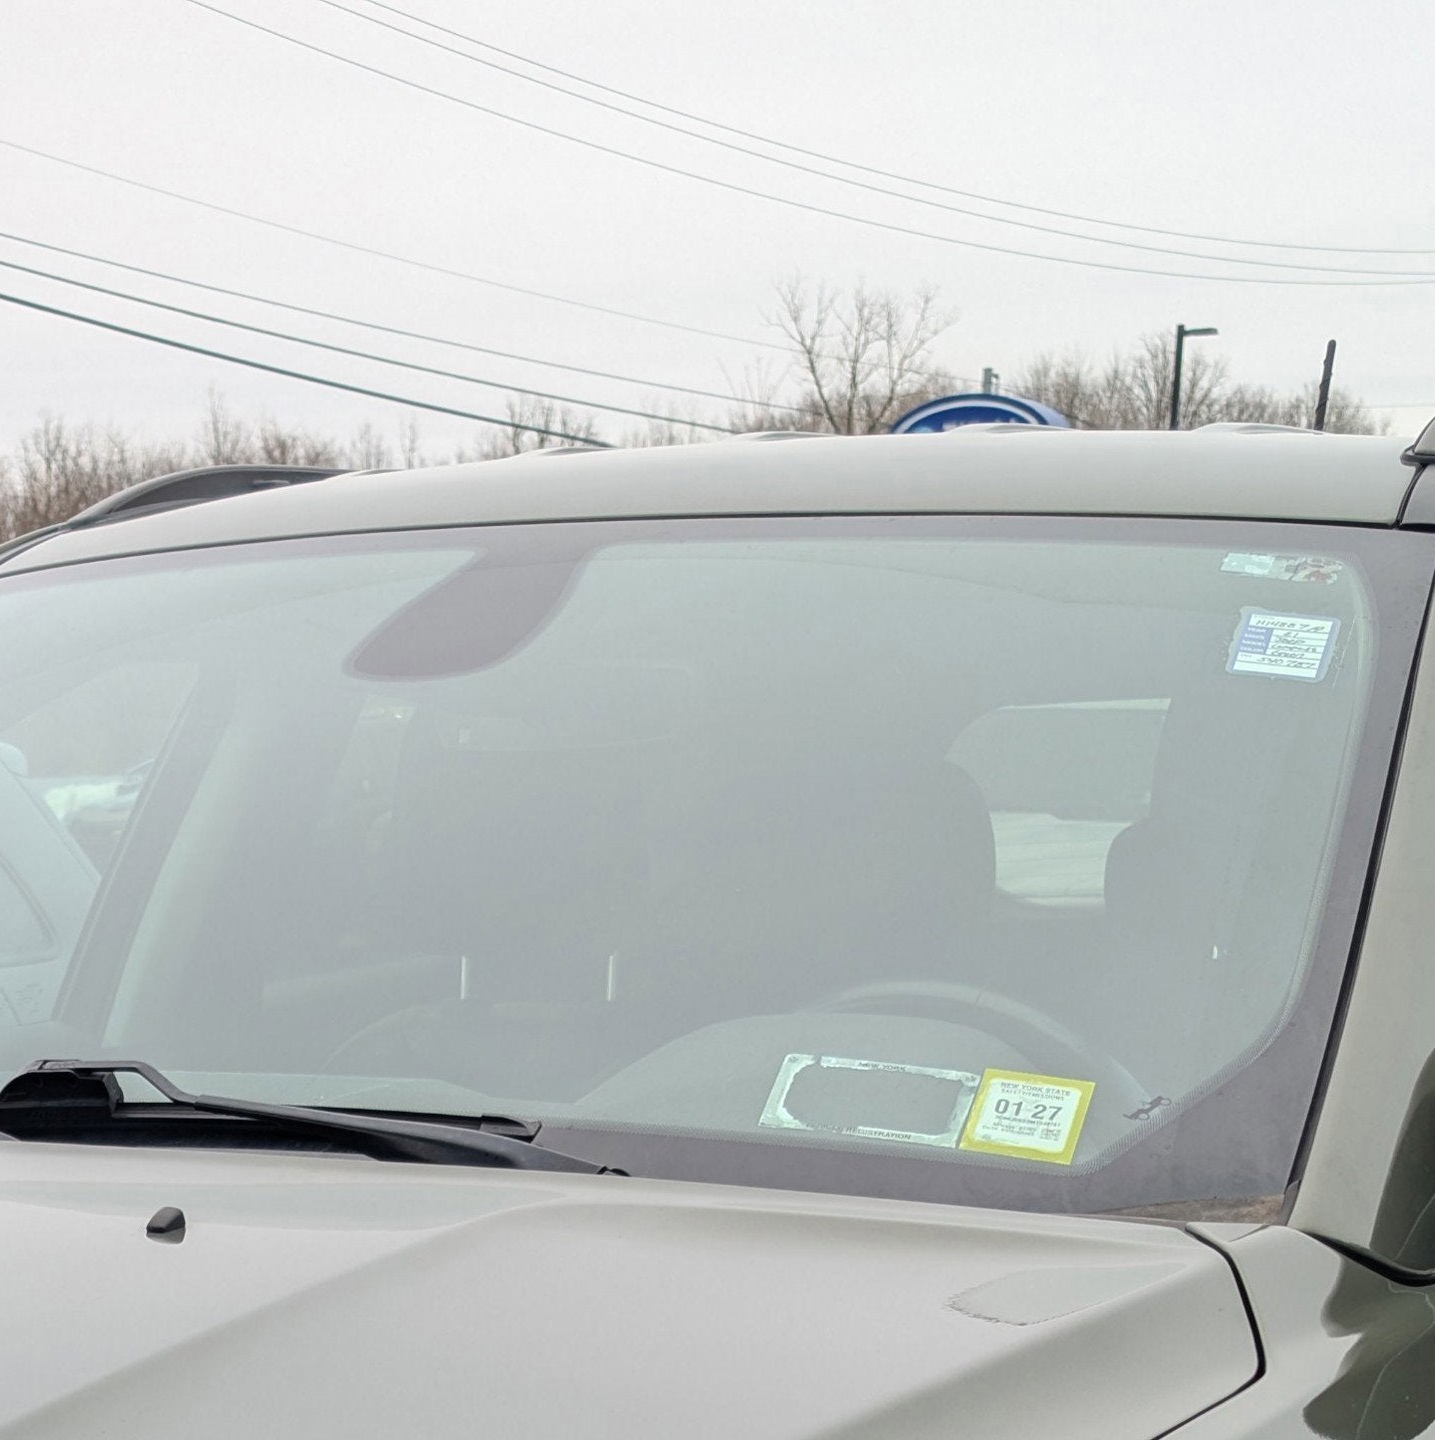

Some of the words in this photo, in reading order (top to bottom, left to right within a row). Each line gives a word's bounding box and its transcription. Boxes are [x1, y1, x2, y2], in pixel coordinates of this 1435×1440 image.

[1000, 1081, 1020, 1089] NEW
[1021, 1084, 1044, 1092] YORK
[1045, 1087, 1071, 1097] STATE
[994, 1098, 1024, 1117] 01
[1031, 1103, 1063, 1121] 27
